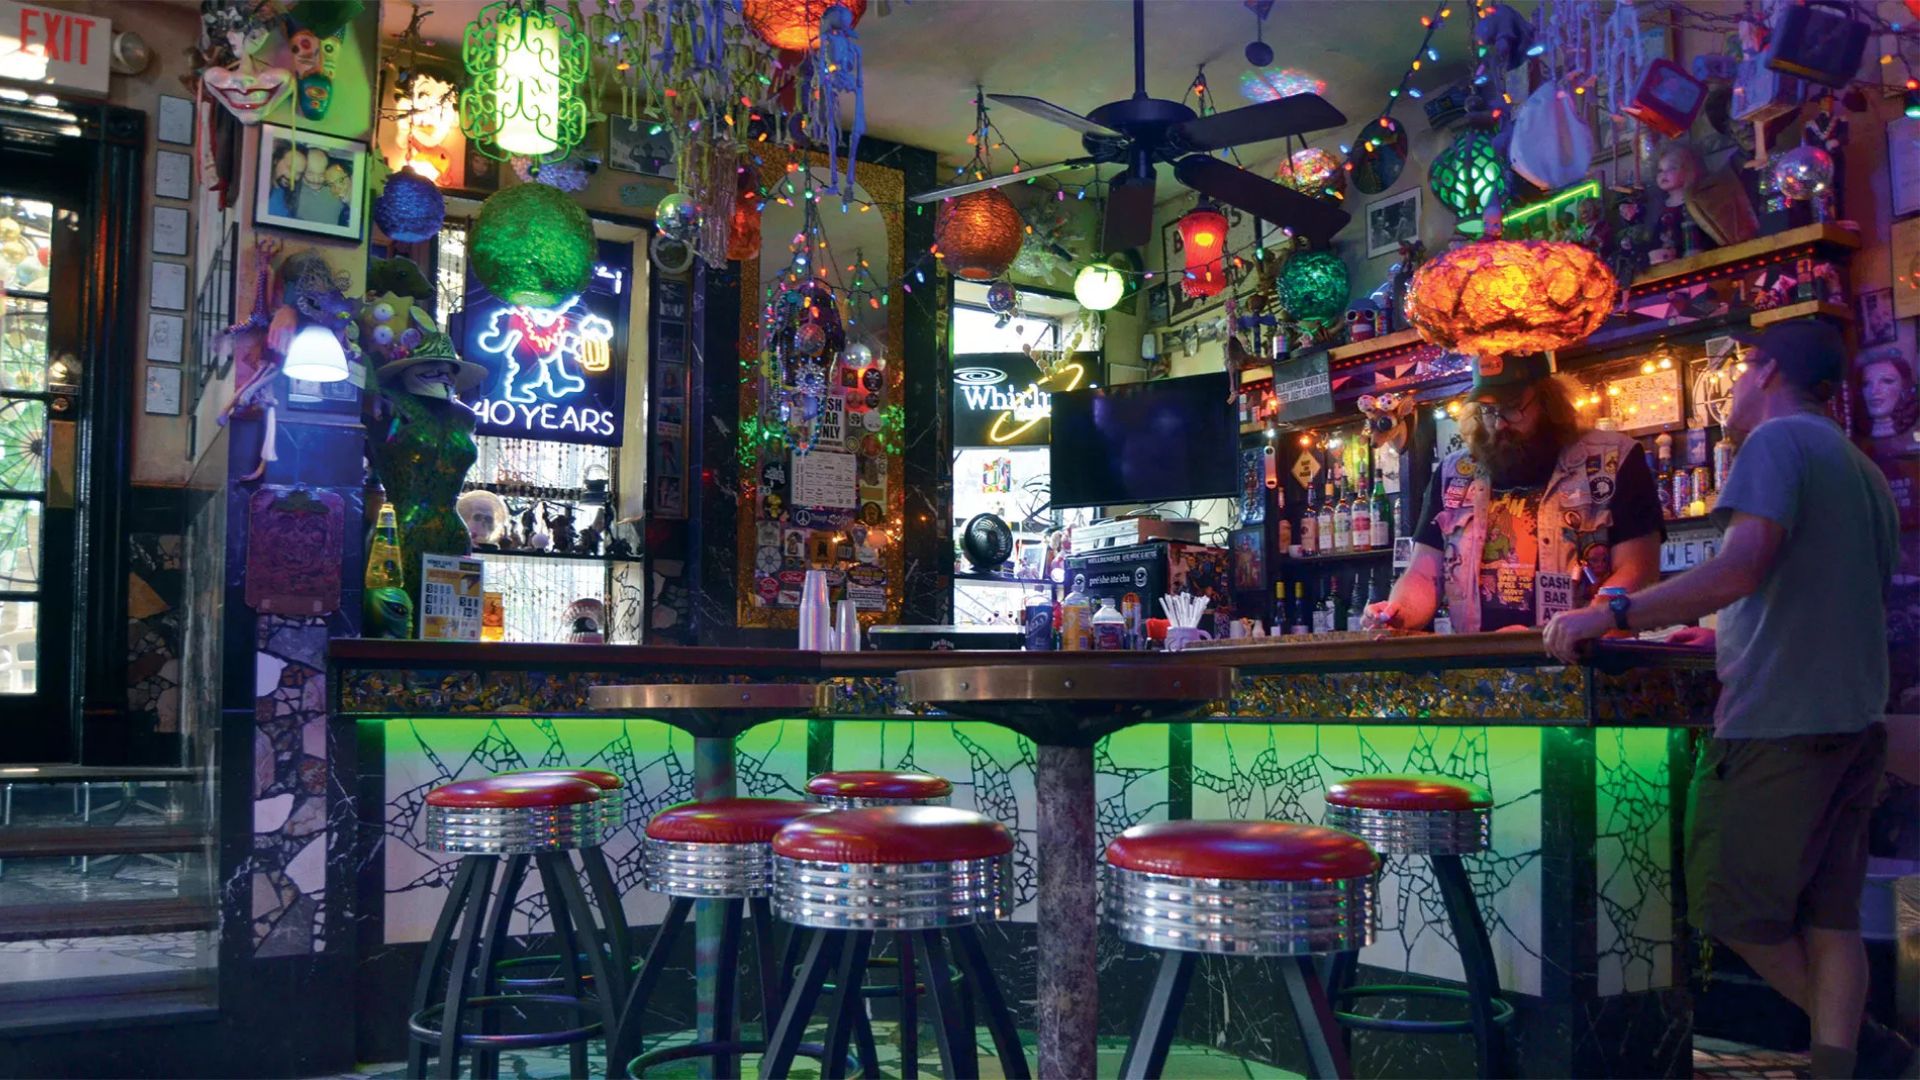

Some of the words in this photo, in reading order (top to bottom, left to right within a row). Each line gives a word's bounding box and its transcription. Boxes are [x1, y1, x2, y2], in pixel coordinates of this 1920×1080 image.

[19, 8, 97, 66] EXIT
[473, 398, 516, 426] 40
[518, 403, 615, 436] YEARS
[1540, 575, 1570, 590] CASH
[1544, 590, 1568, 604] BAR
[1543, 607, 1569, 620] AT
